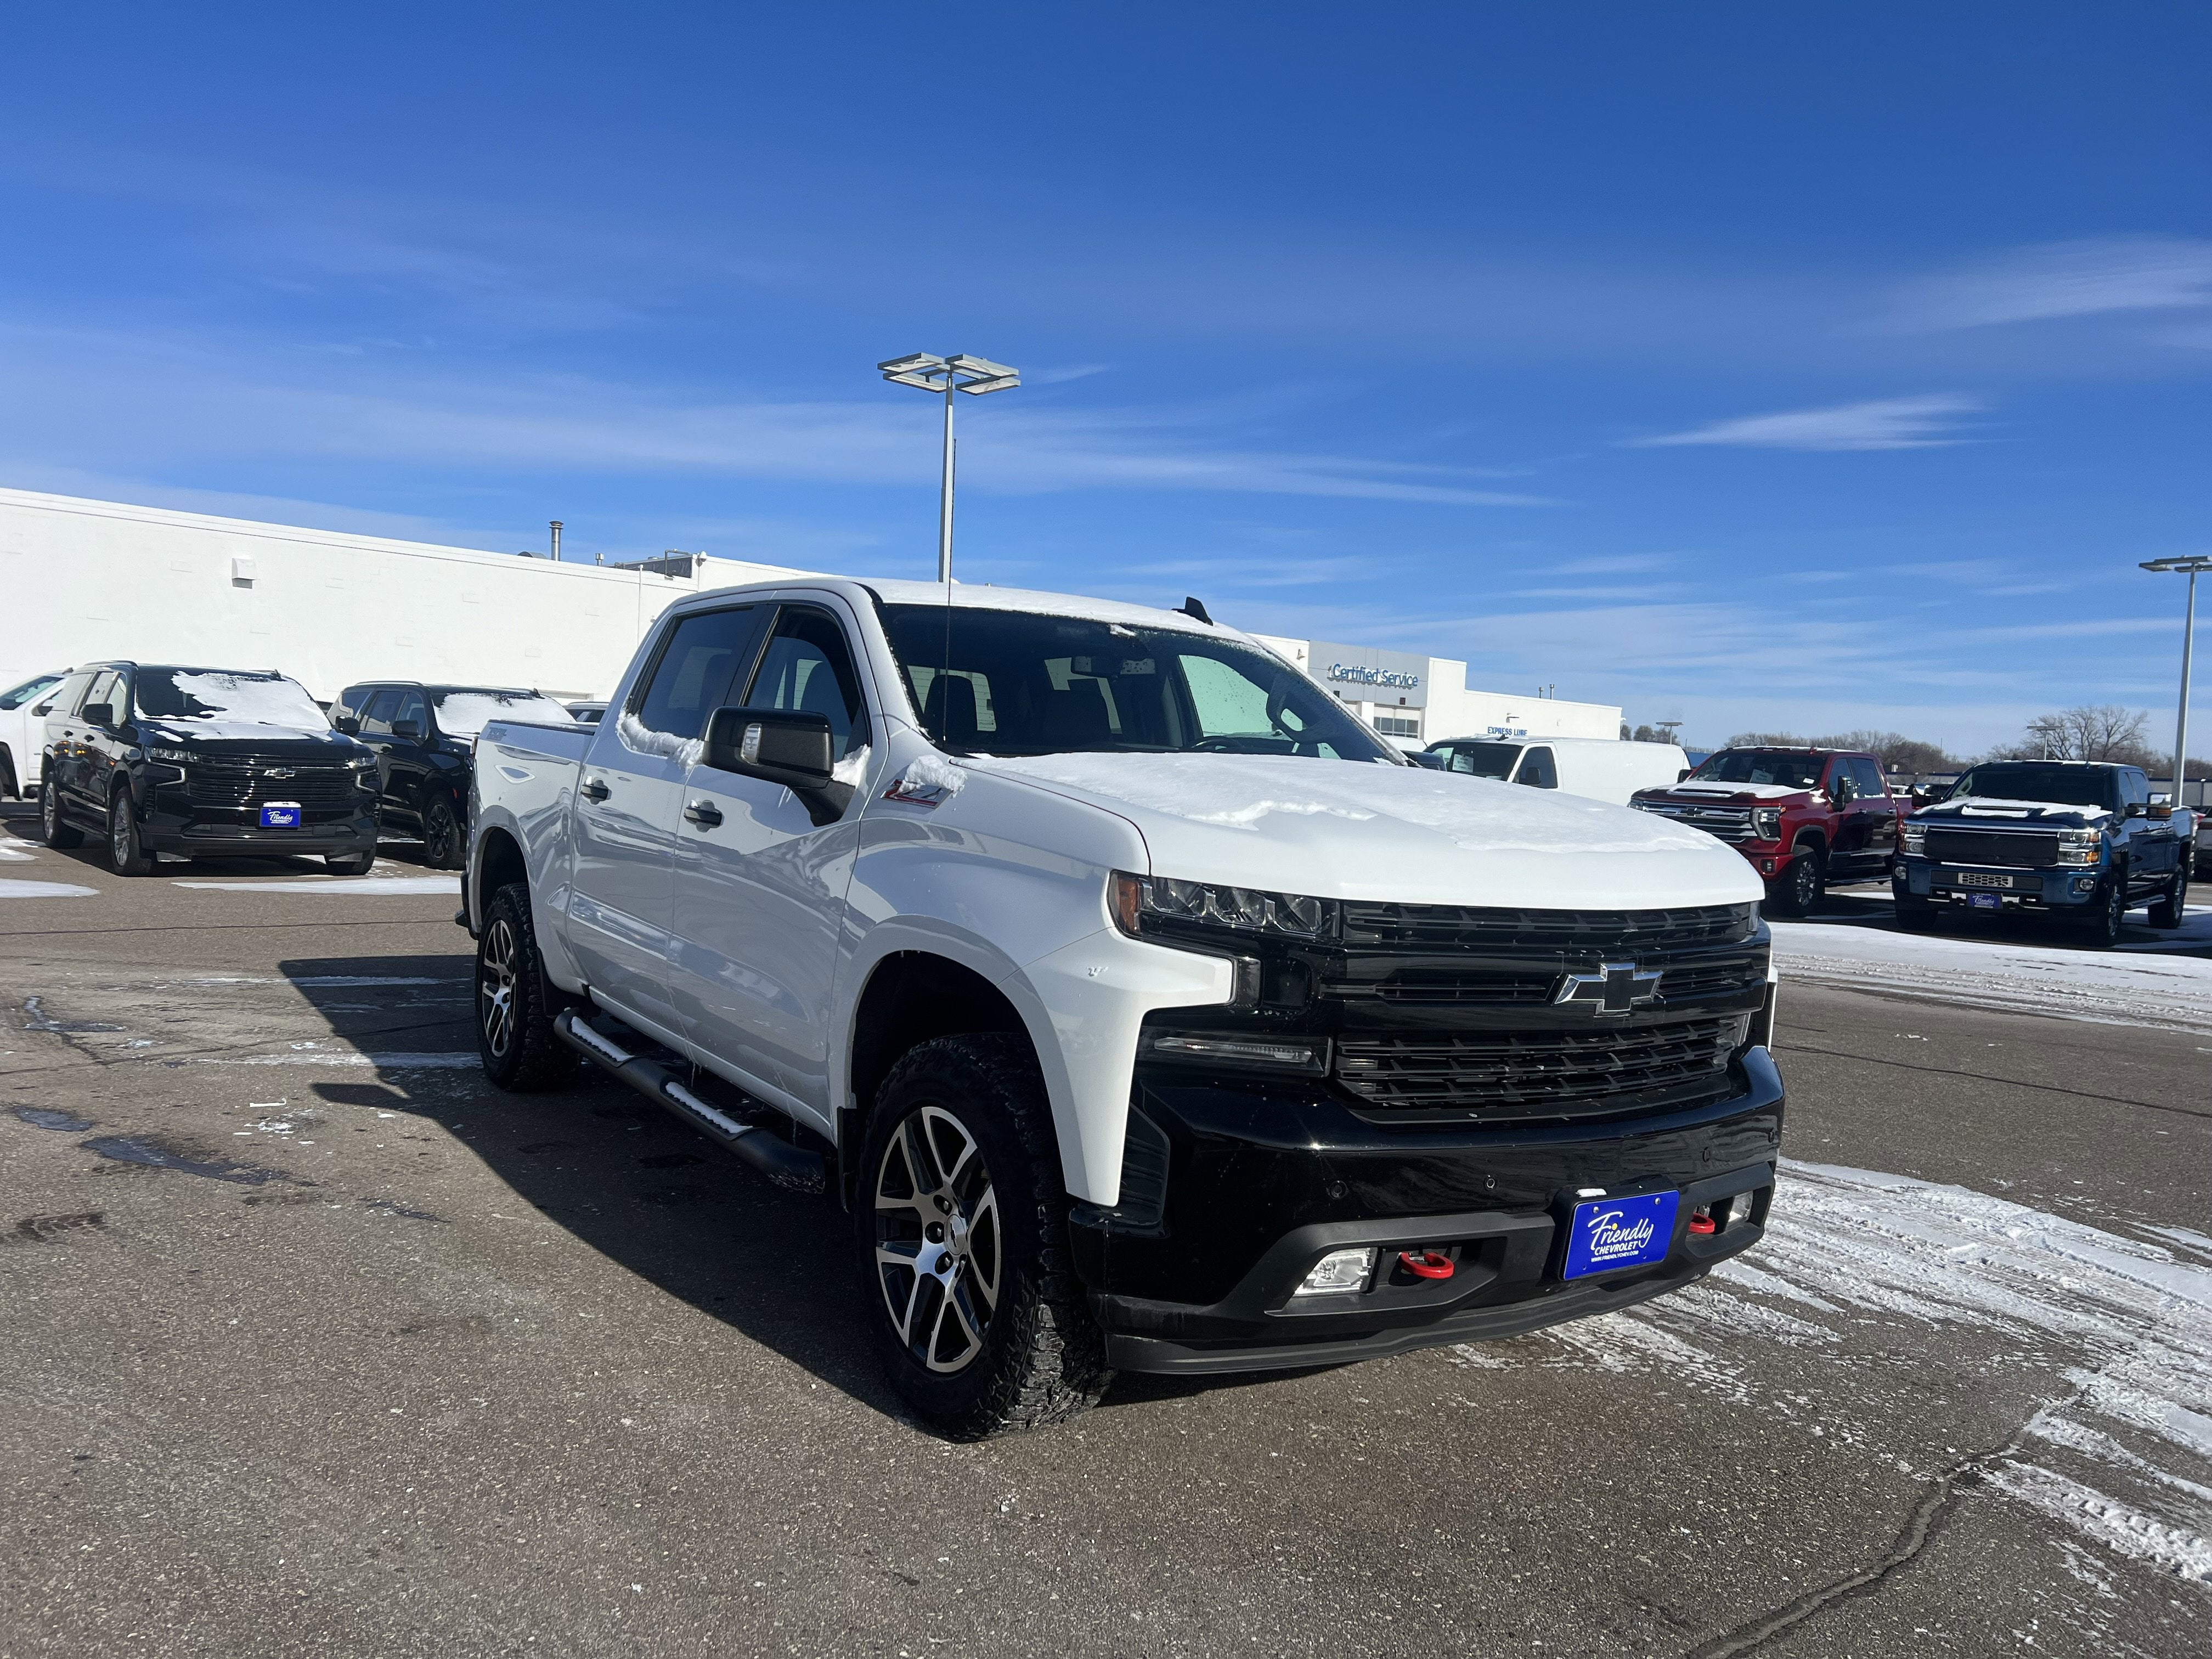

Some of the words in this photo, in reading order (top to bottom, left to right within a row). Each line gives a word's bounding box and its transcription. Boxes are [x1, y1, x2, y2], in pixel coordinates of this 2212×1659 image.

[1333, 663, 1379, 682] Certified
[1383, 669, 1418, 687] Service
[1487, 726, 1512, 735] EXPRESS
[267, 811, 293, 822] Friendly
[1588, 1211, 1654, 1251] Friendly
[1594, 1241, 1638, 1256] CHEVROLET
